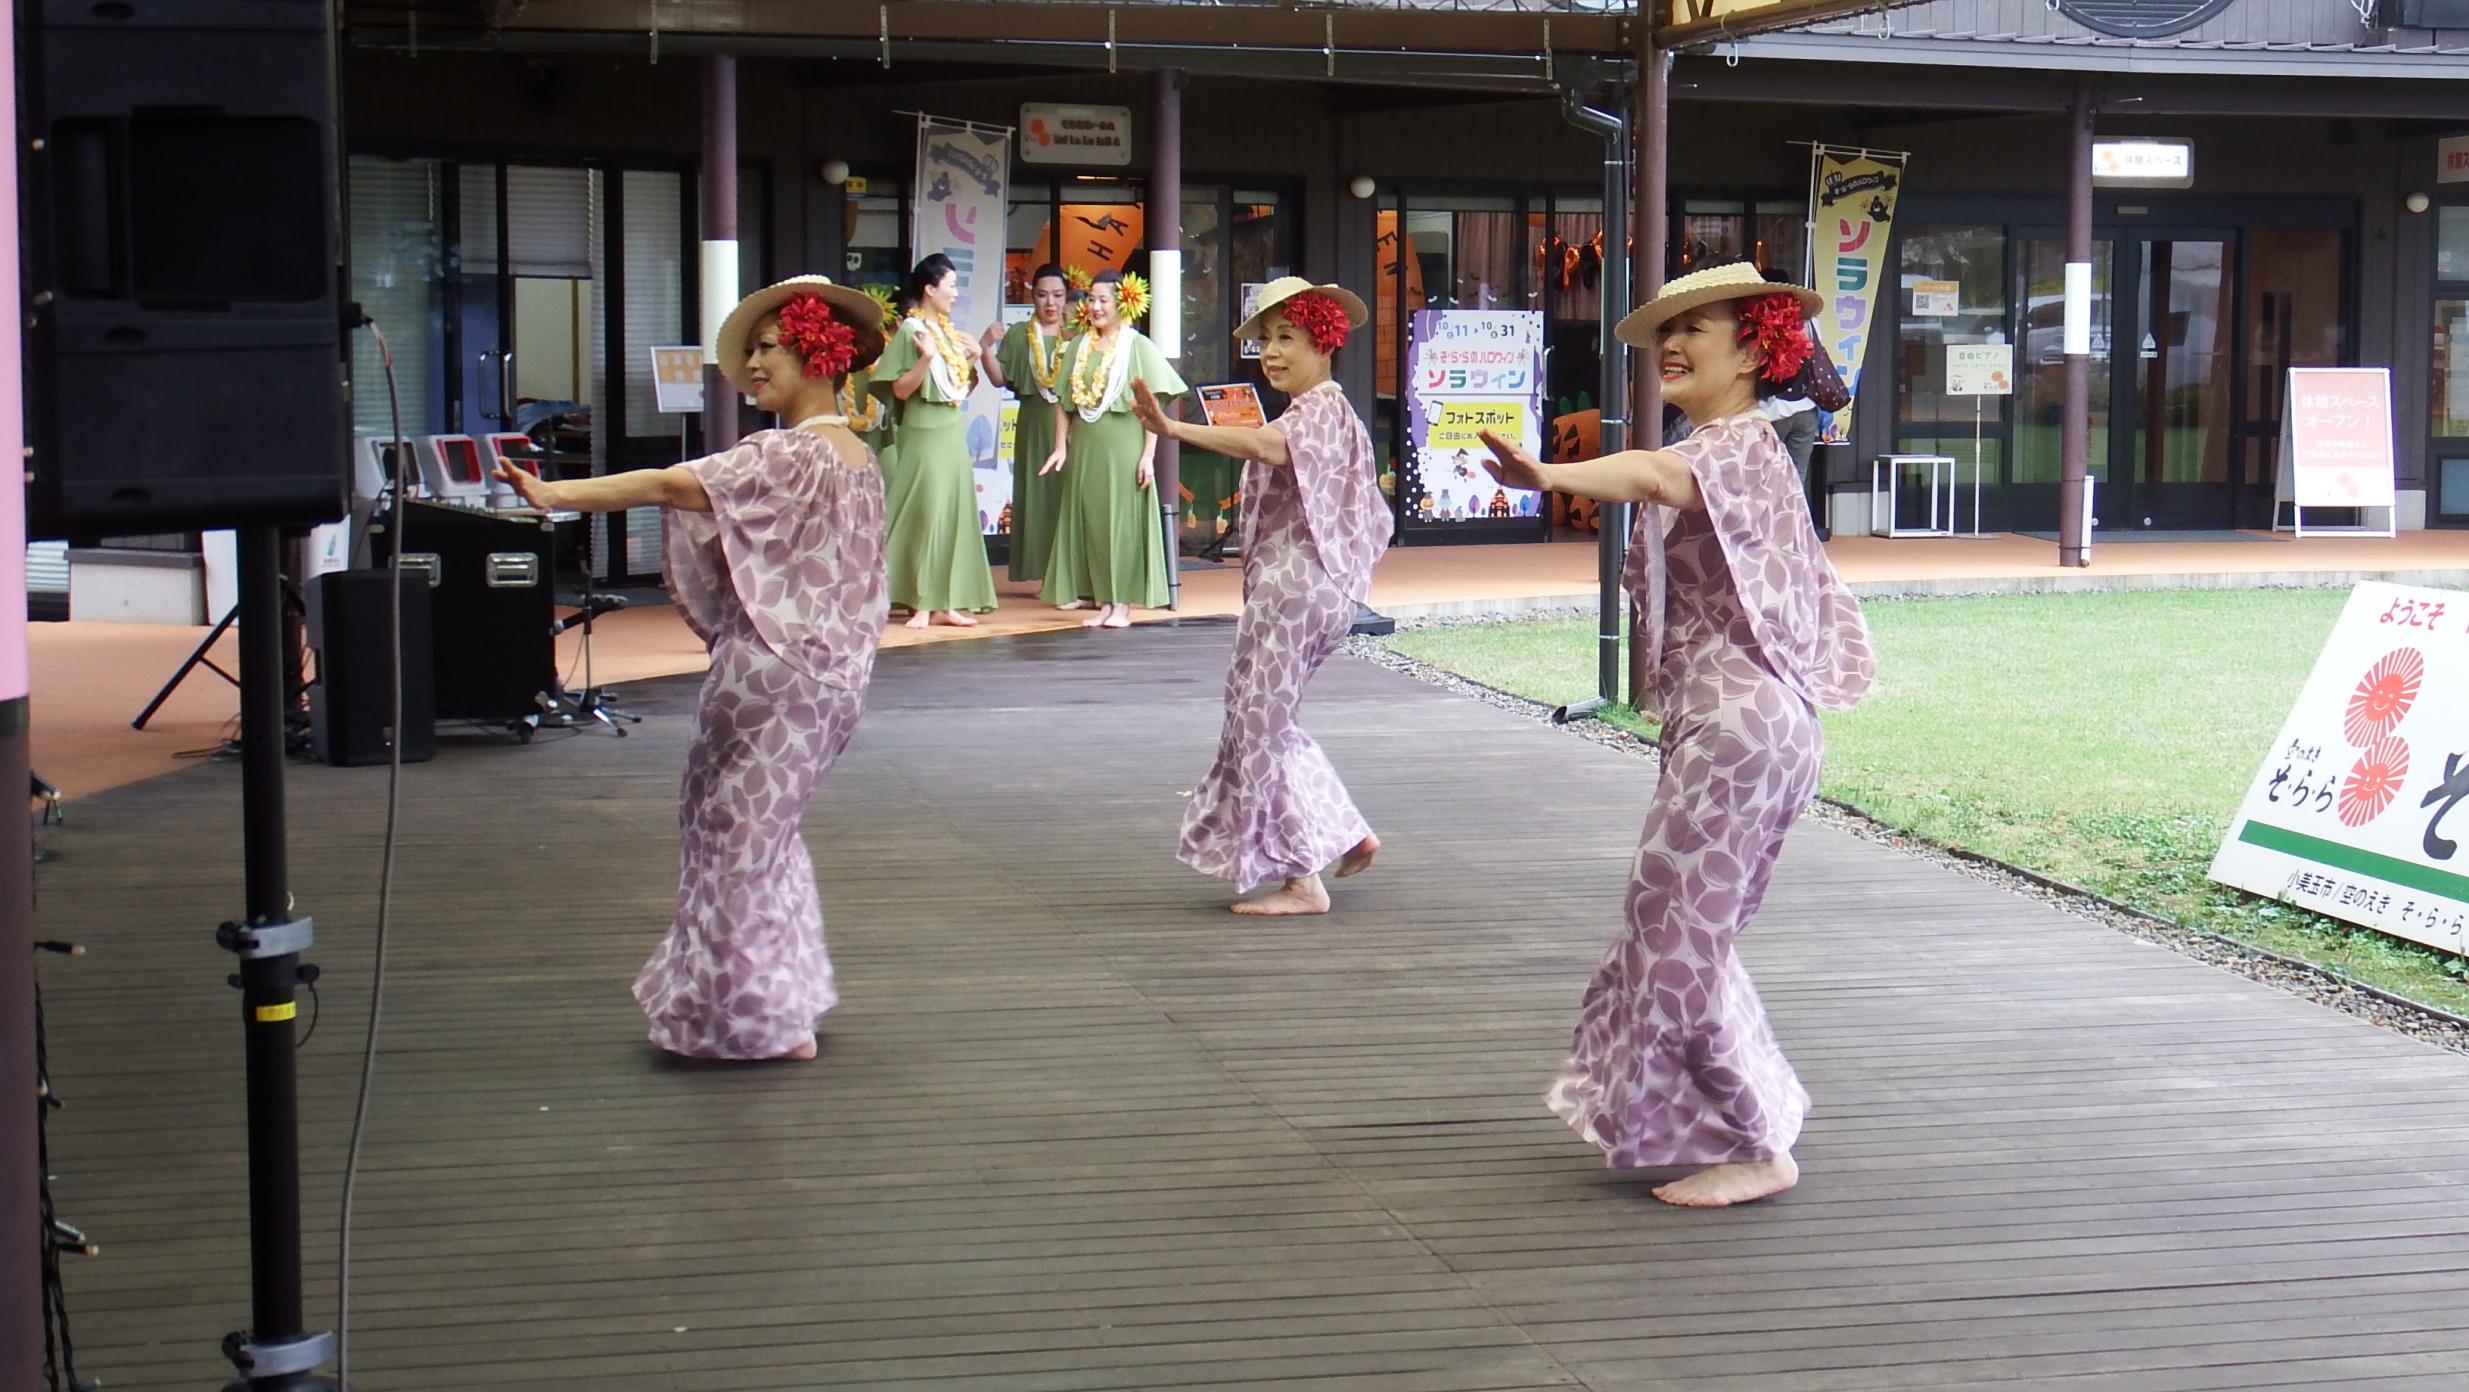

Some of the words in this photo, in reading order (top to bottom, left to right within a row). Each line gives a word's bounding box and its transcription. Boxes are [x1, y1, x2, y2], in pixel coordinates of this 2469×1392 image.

[1428, 370, 1526, 389] ソラウィン
[1446, 409, 1515, 425] フォトスポット
[2379, 597, 2446, 631] ようこそ
